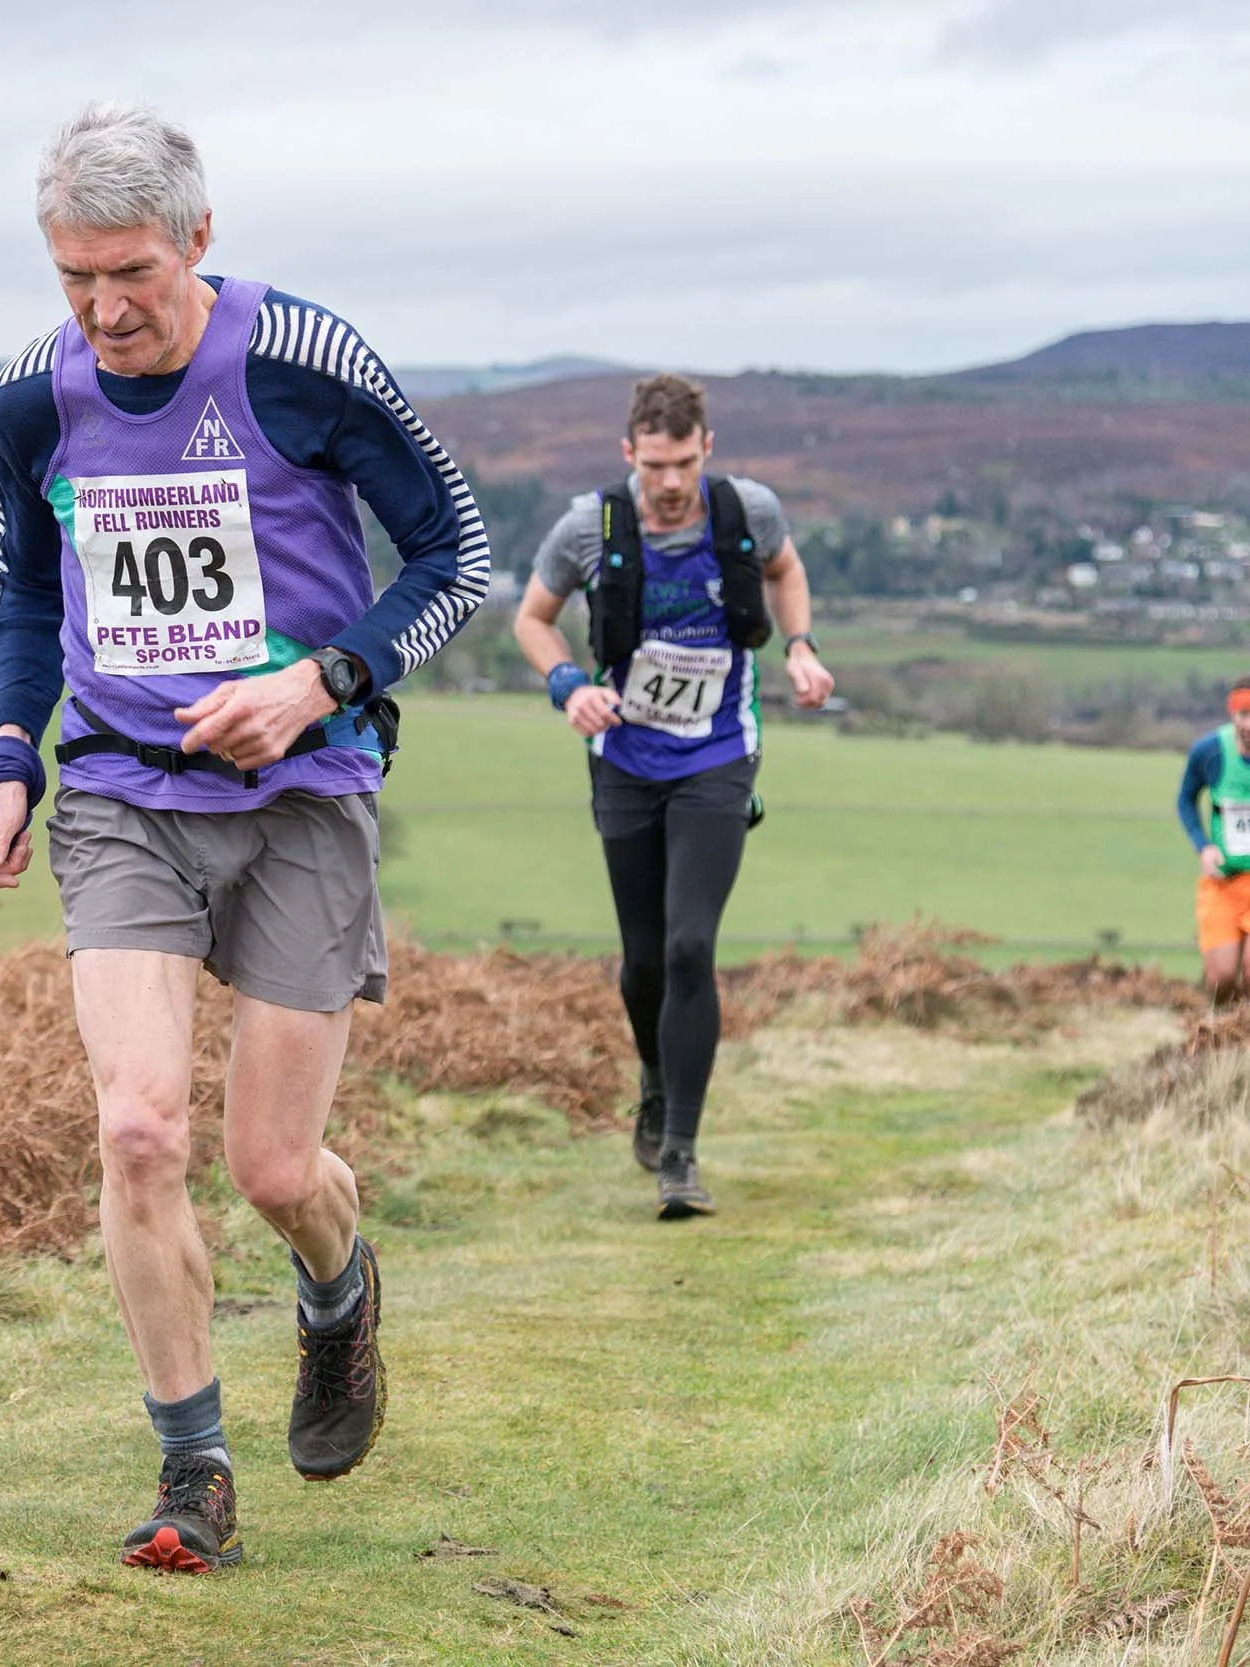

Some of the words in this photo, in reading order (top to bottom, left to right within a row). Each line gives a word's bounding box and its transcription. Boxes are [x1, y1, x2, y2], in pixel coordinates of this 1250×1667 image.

[203, 419, 220, 437] N
[78, 482, 240, 509] NORTHUMBERLAND
[94, 513, 130, 533] FELL
[135, 509, 222, 531] RUNNERS
[111, 536, 235, 617] 403
[97, 626, 159, 646] PETE
[168, 619, 261, 645] BLAND
[136, 644, 217, 664] SPORTS
[643, 674, 706, 713] 471
